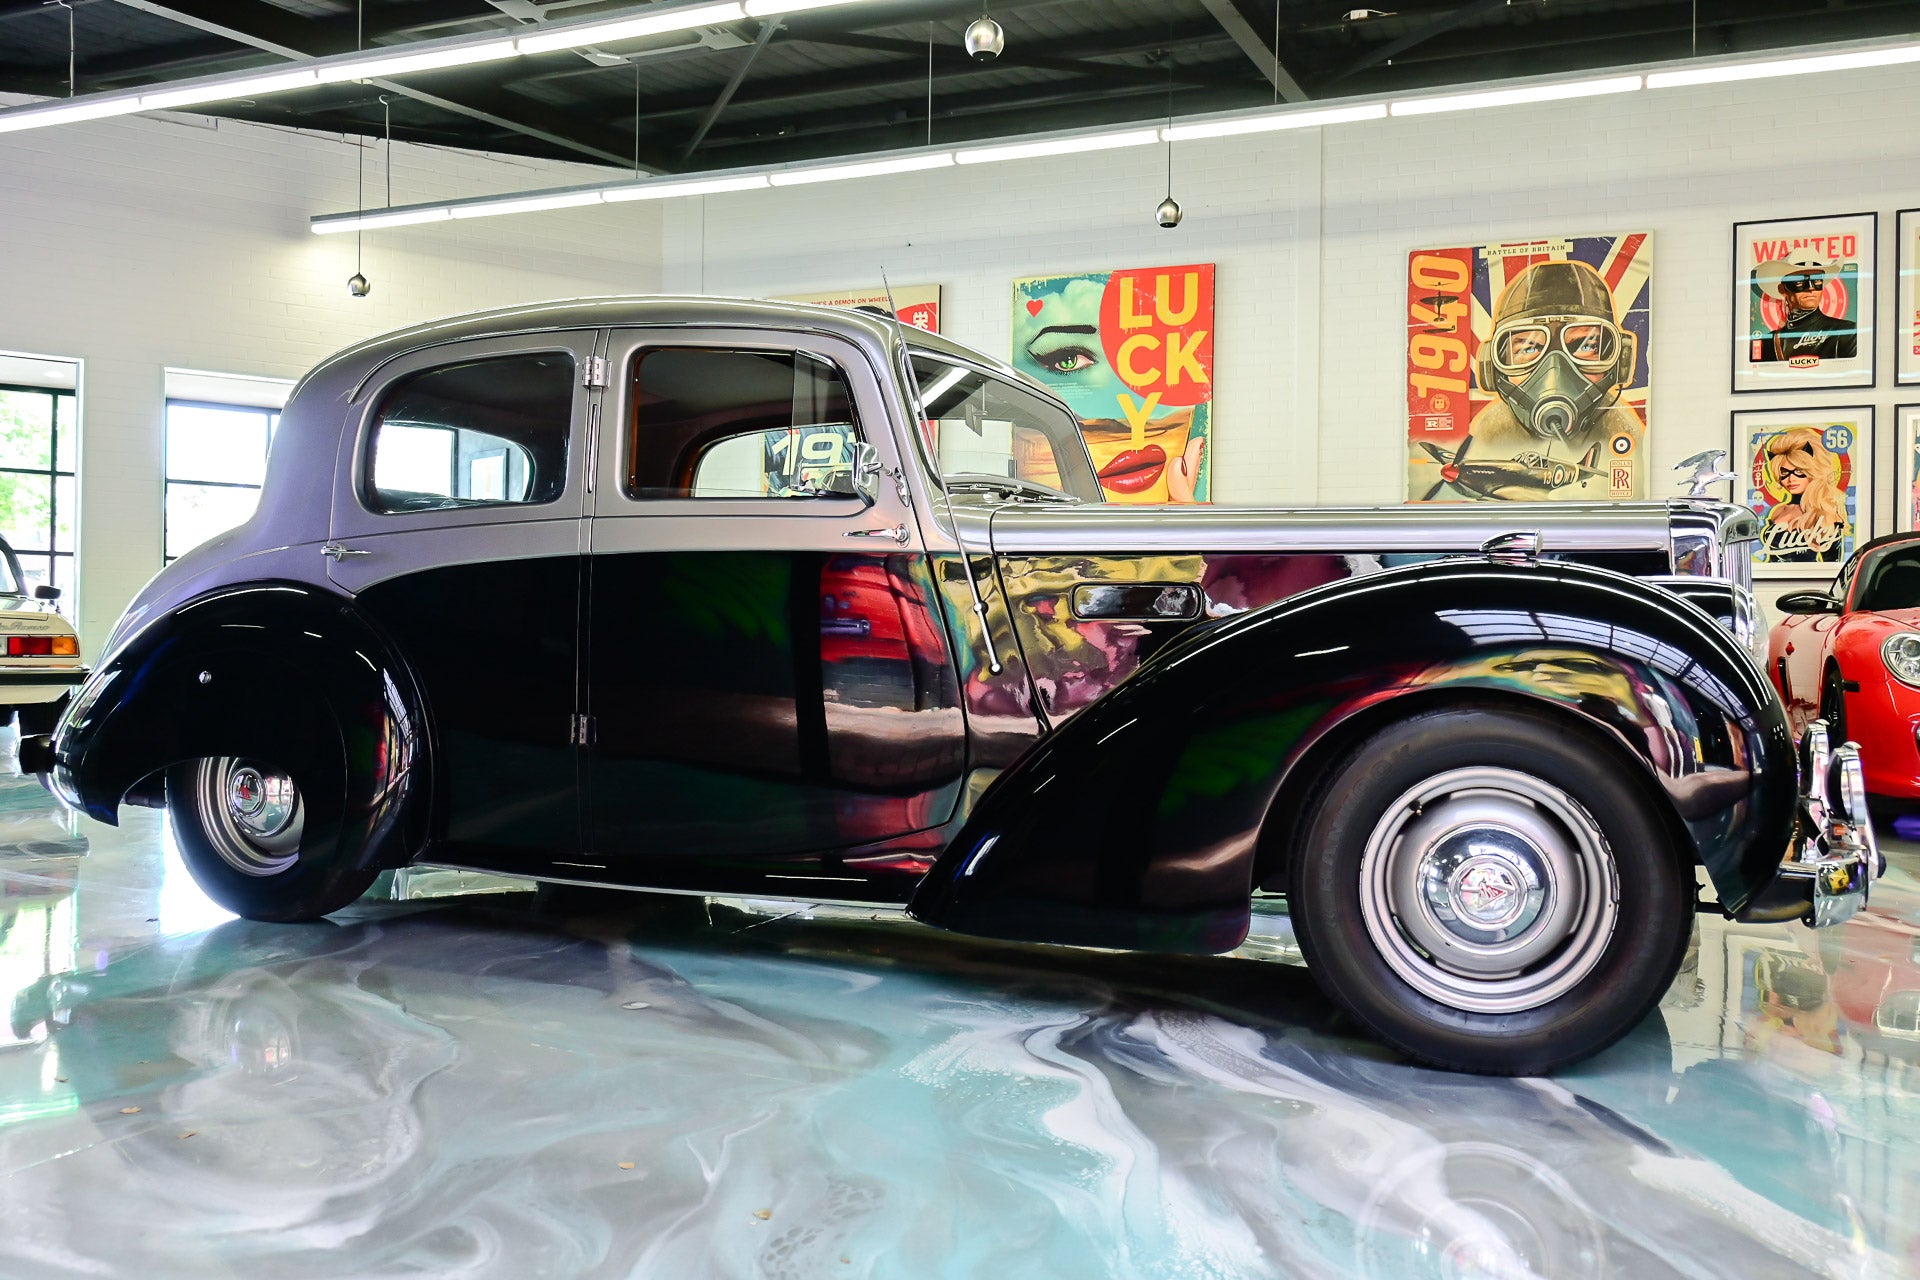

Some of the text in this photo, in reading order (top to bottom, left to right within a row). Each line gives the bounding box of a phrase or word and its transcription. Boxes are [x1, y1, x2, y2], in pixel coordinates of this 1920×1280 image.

[1119, 272, 1199, 328] LU
[1409, 254, 1469, 399] 1940
[1793, 330, 1829, 350] Lucky
[1116, 330, 1210, 387] CK
[1790, 358, 1818, 366] LUCKY
[1116, 391, 1163, 451] Y
[1826, 430, 1848, 449] 56
[771, 431, 857, 476] 19
[1543, 470, 1552, 485] 13
[1753, 516, 1843, 556] Lucky
